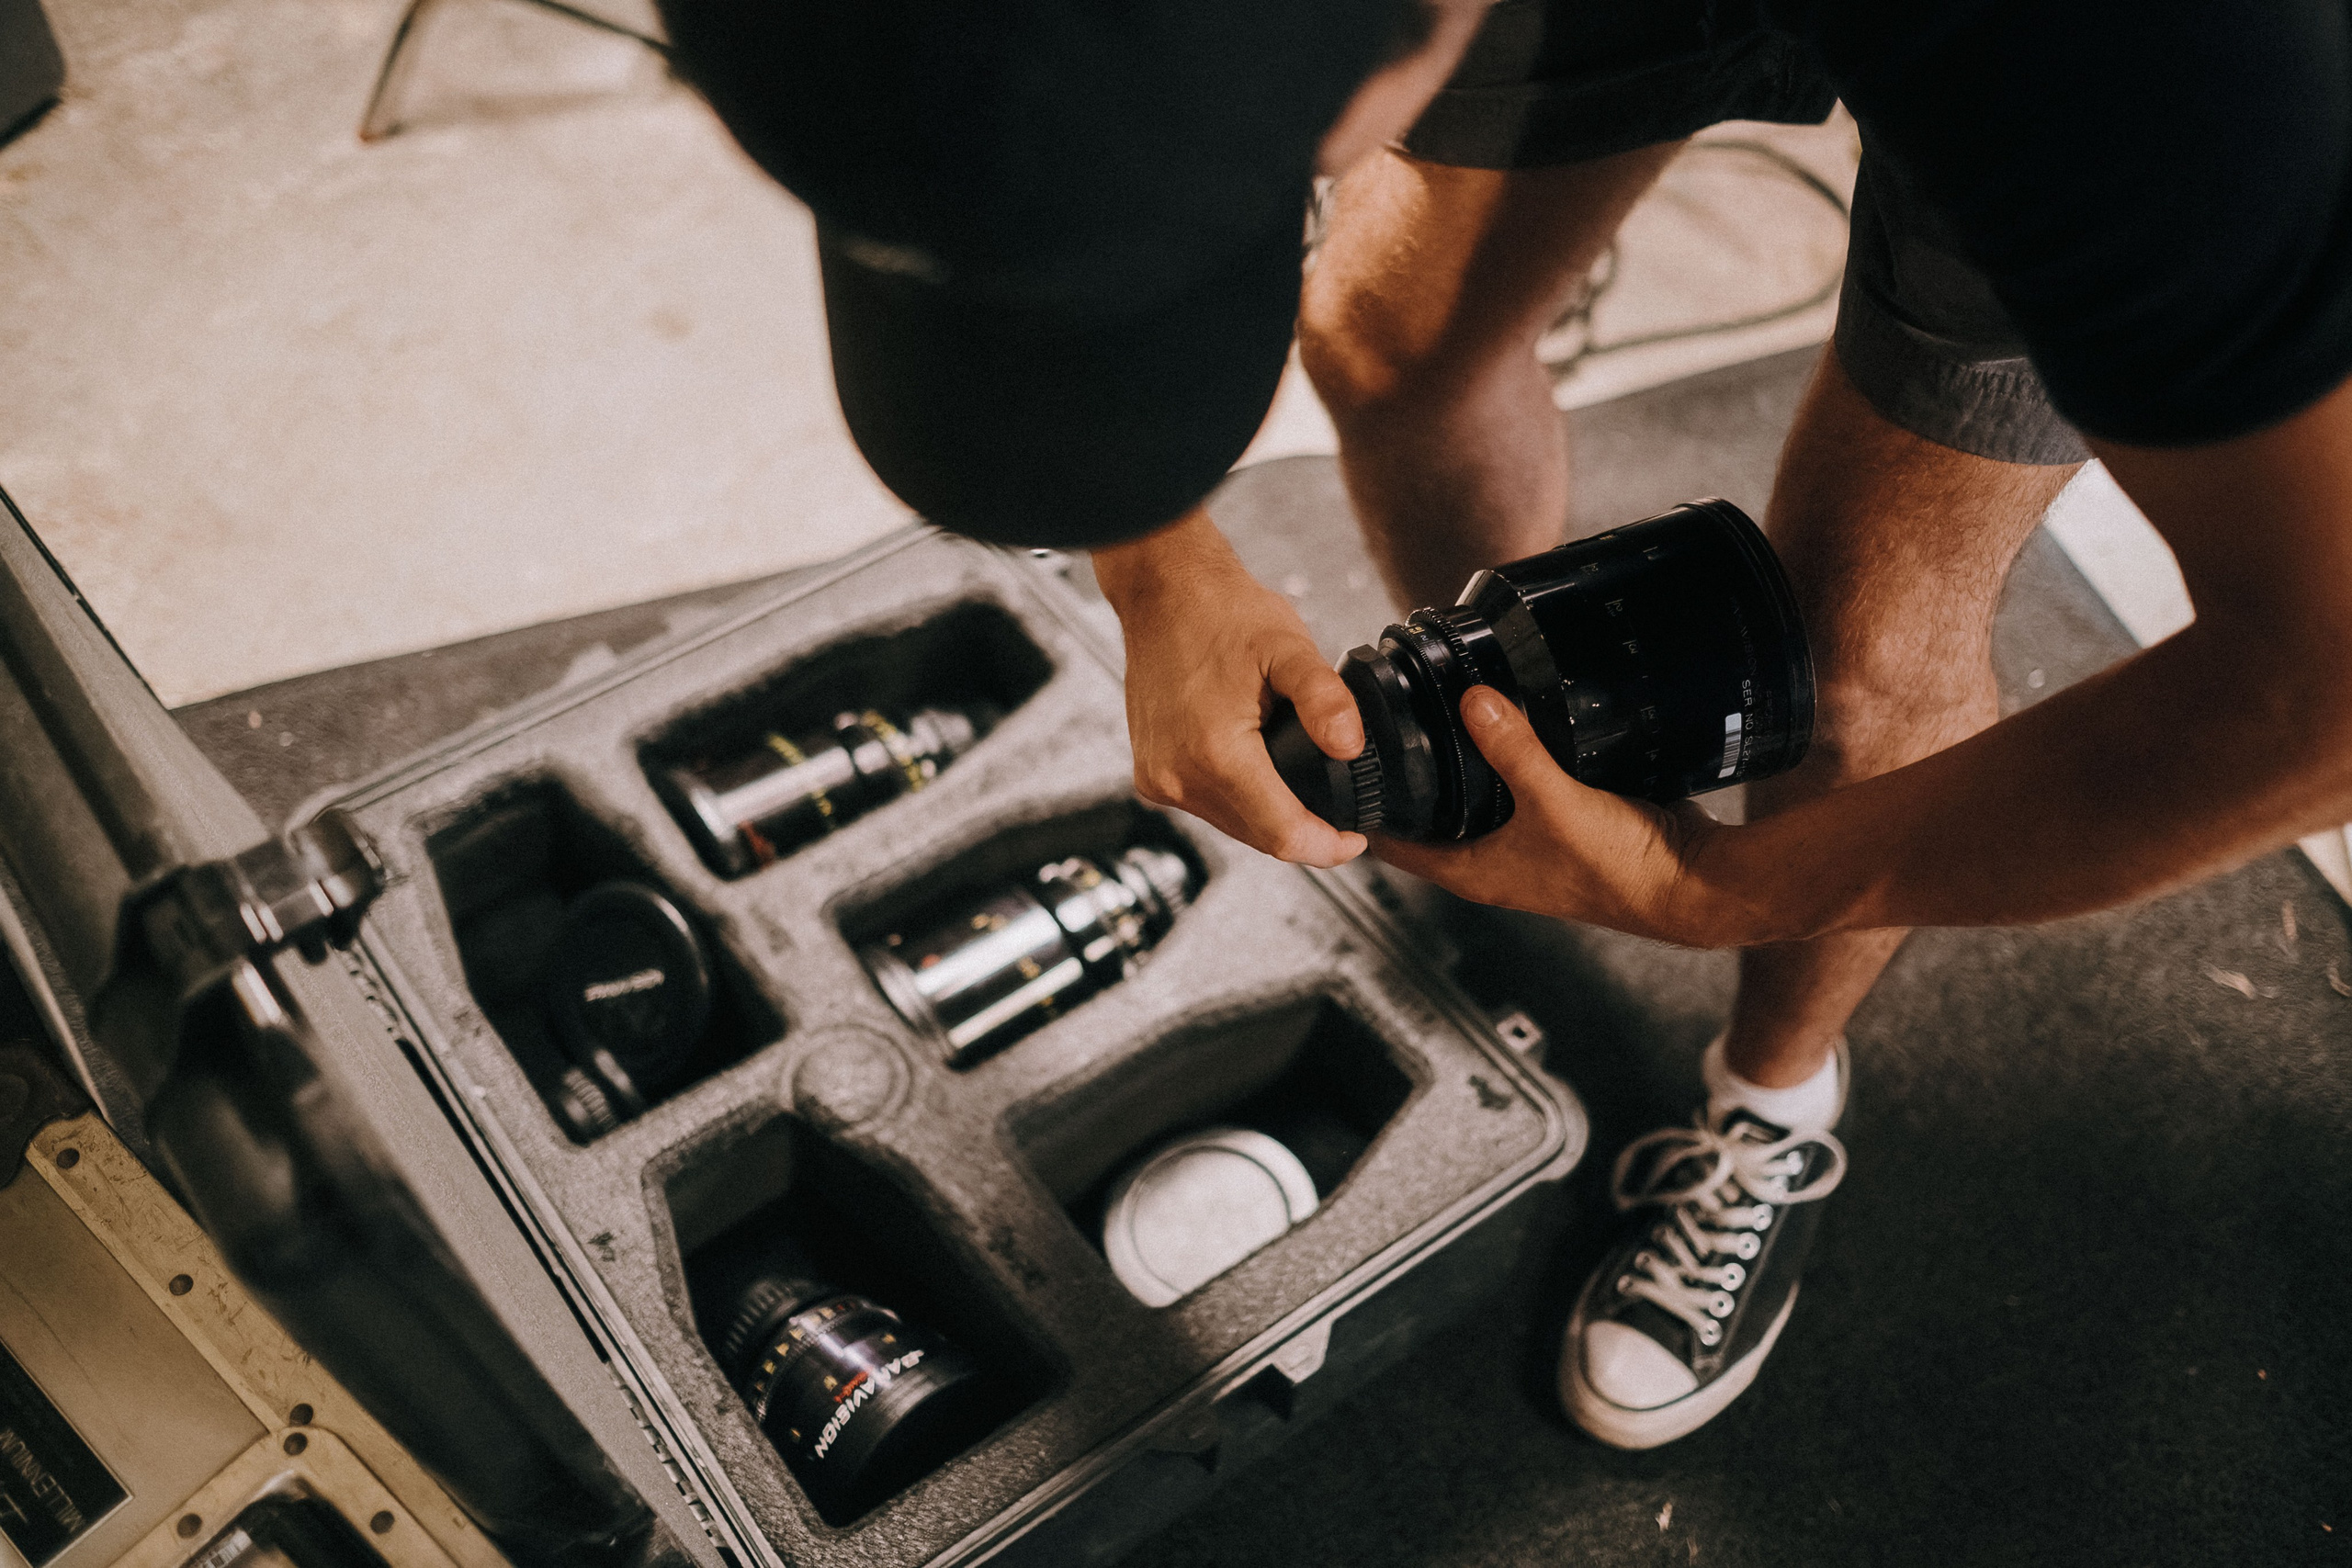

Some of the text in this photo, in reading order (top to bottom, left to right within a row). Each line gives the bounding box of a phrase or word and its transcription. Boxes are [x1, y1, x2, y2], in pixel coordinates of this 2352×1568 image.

[1742, 679, 1753, 707] SER
[1746, 713, 1754, 730] NO
[814, 1349, 924, 1459] PANAVISION
[0, 1428, 85, 1533] MILLENNIUM
